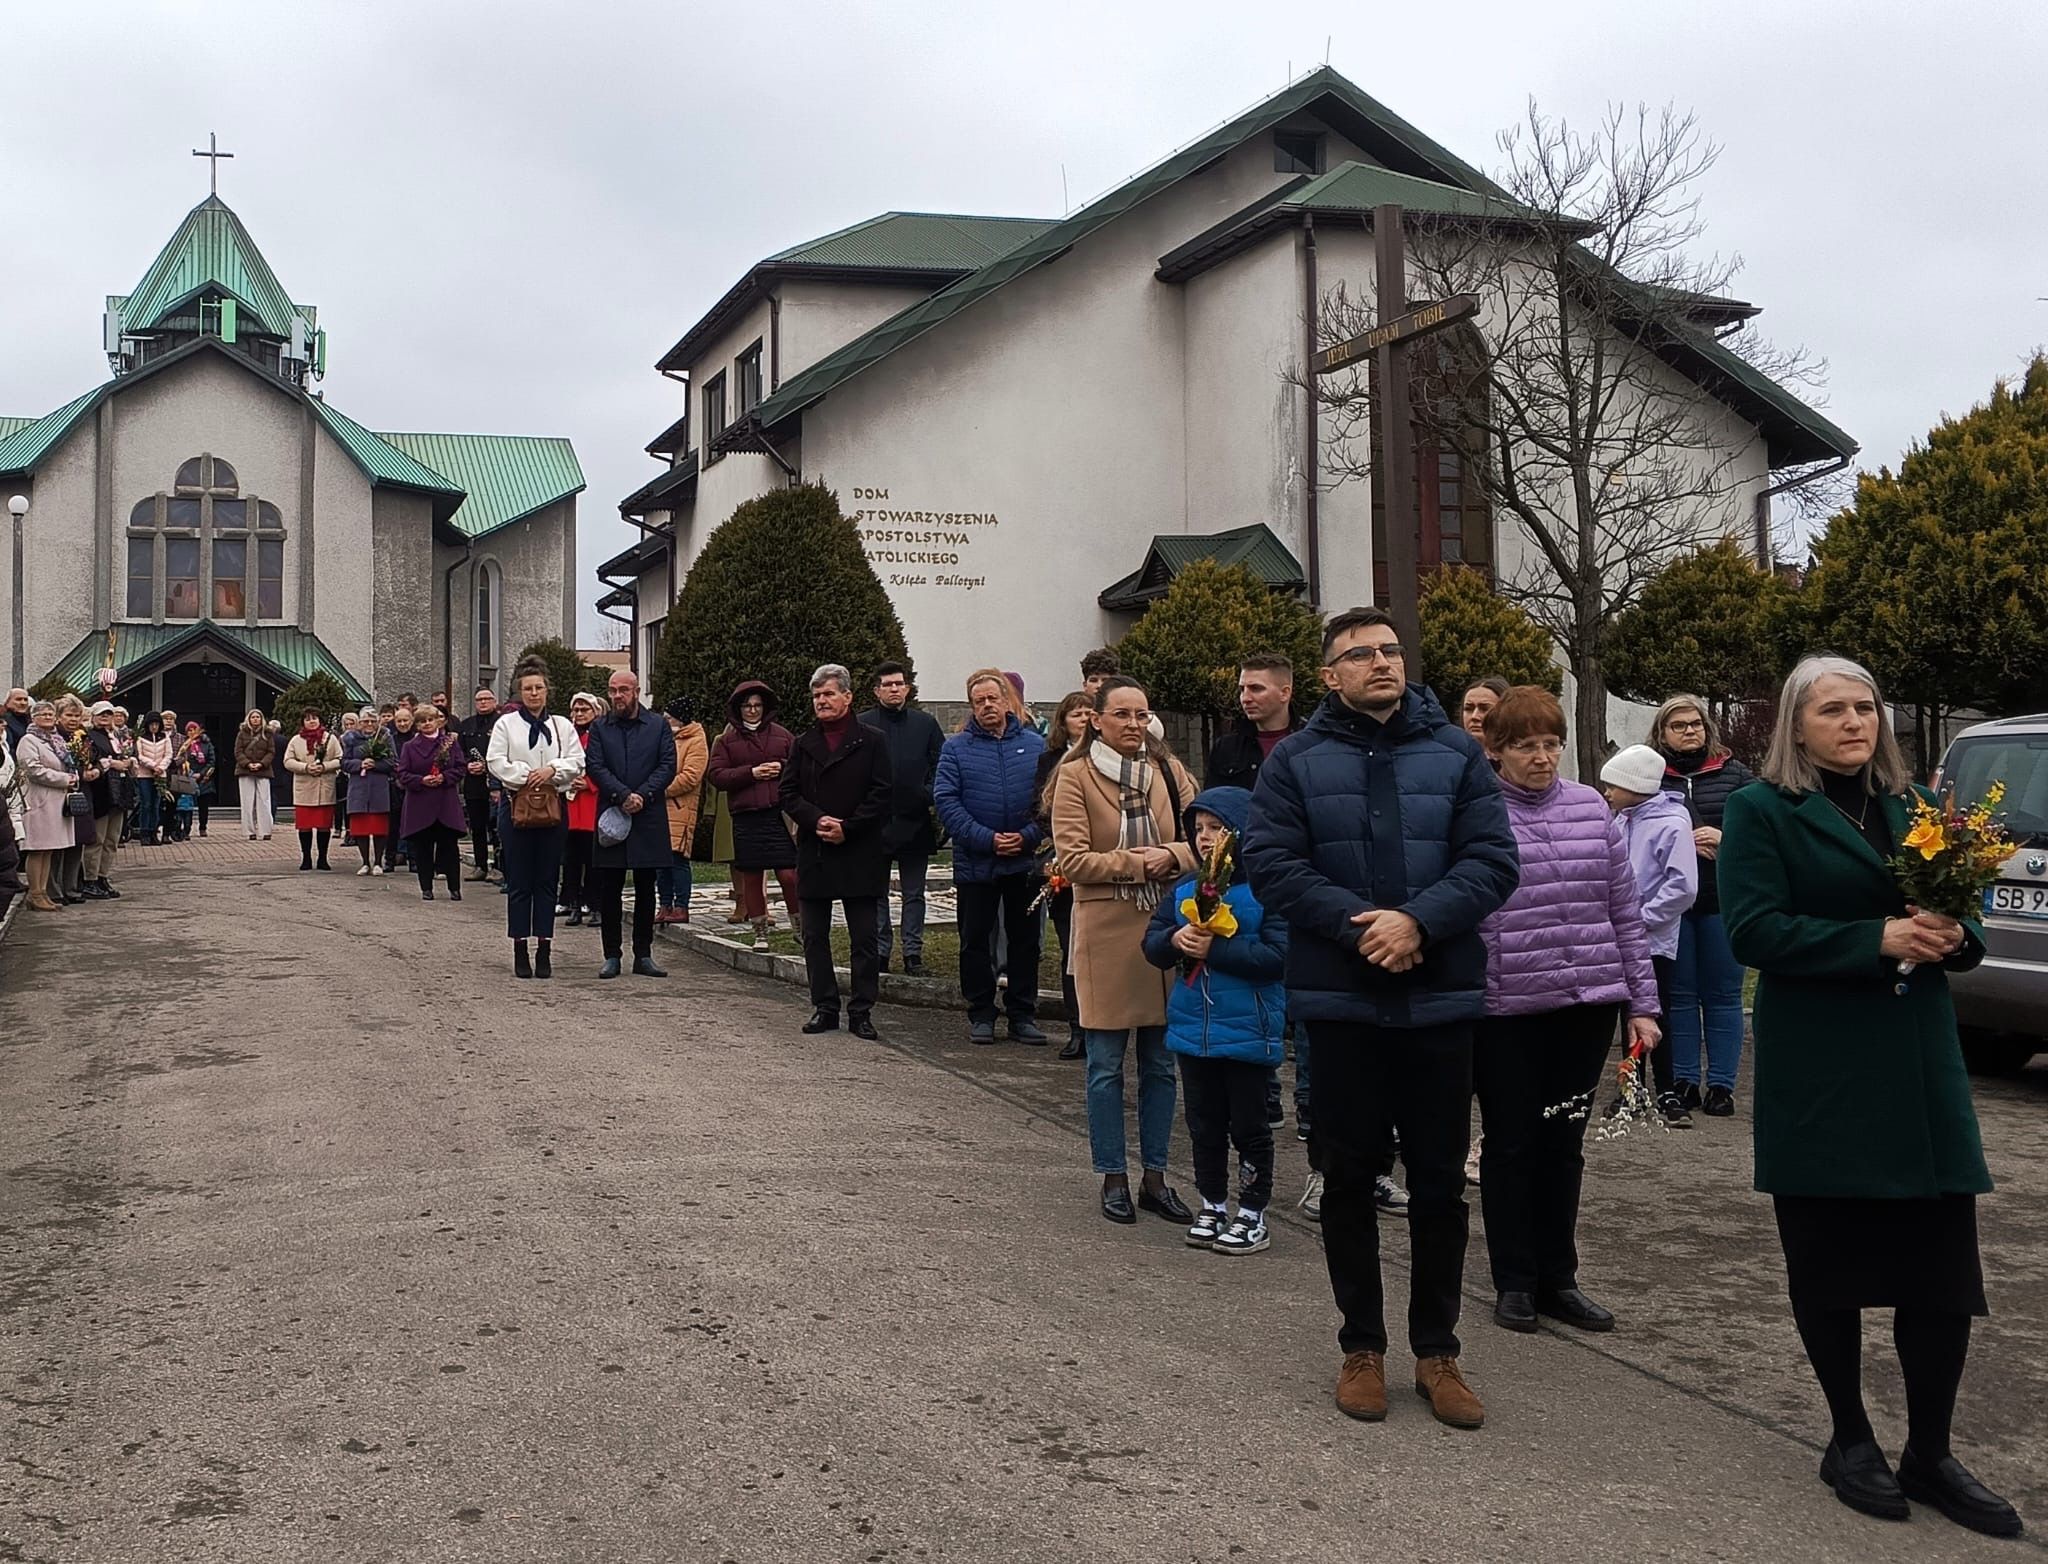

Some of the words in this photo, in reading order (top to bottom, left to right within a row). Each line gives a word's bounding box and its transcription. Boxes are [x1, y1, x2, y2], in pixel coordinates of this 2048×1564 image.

[1325, 341, 1352, 367] JEZU
[1412, 302, 1447, 331] TOBIE
[853, 487, 889, 500] DOM
[855, 509, 999, 527] STOWARZYSZENIA
[855, 529, 970, 546] APOSTOLSTWA
[864, 550, 959, 565] ATOLICKIEGO
[1996, 887, 2025, 910] SB
[2032, 890, 2048, 911] 9
